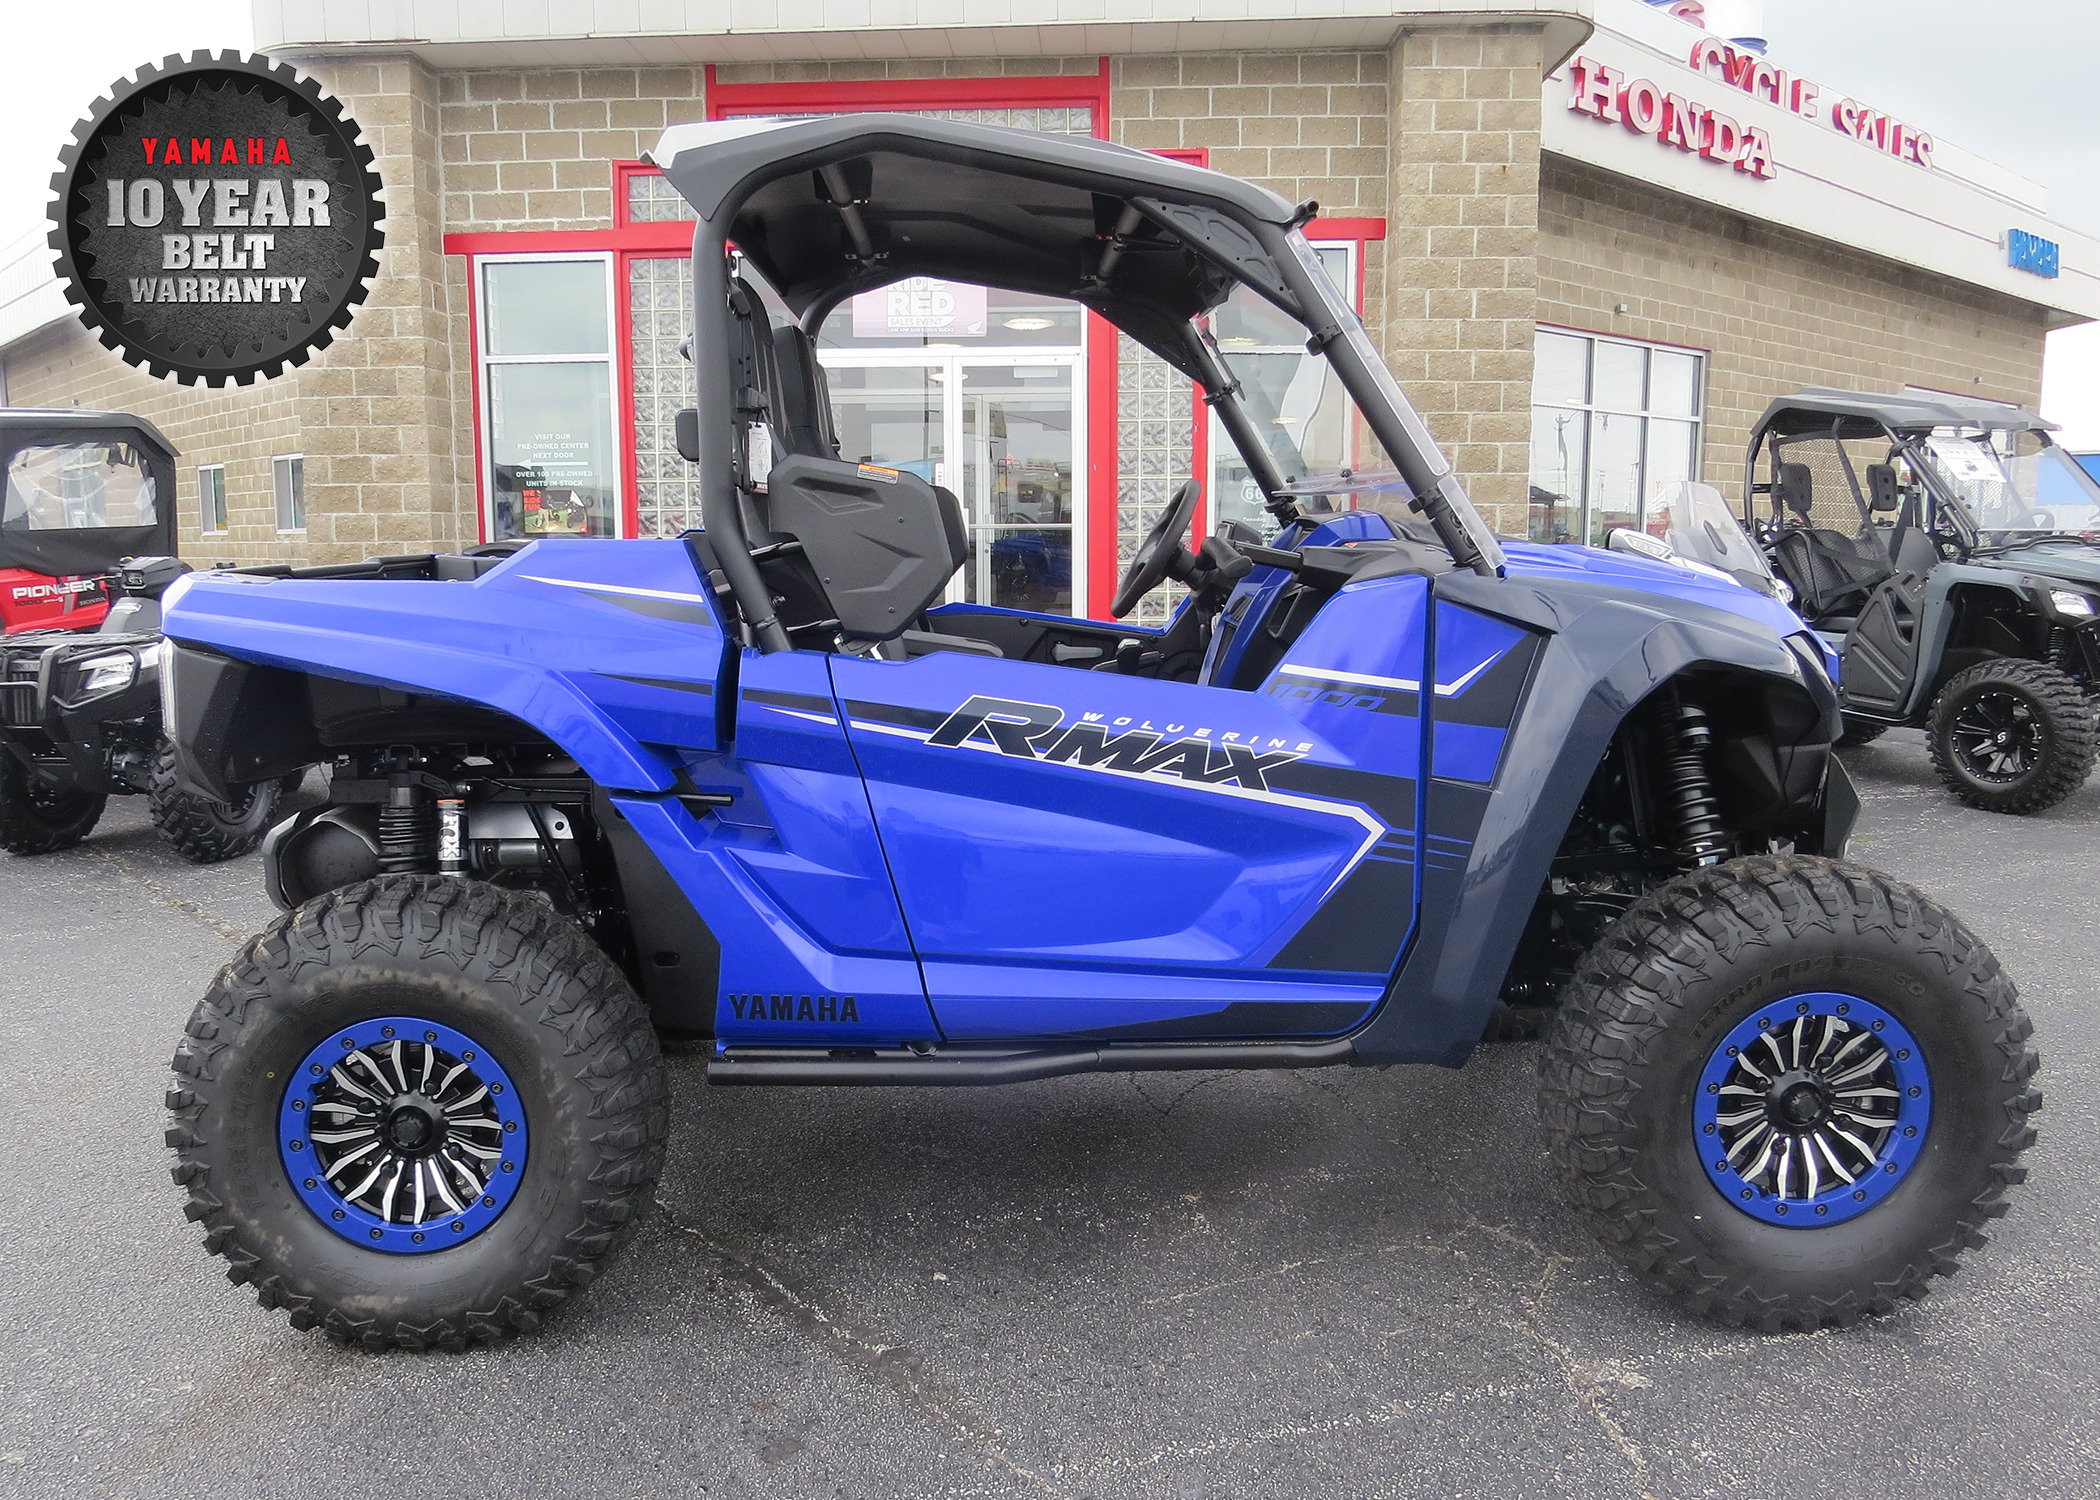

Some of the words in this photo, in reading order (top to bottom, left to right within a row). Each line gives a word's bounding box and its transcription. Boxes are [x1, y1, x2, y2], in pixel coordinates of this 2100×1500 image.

[1568, 56, 1777, 180] HONDA
[888, 291, 956, 316] RED
[890, 317, 914, 326] SALES
[916, 317, 943, 326] EVENT
[1245, 487, 1263, 500] 66
[12, 580, 96, 599] PIONEER
[79, 596, 107, 606] HONDA
[1269, 683, 1387, 712] 1000
[923, 694, 1310, 793] RMAX
[1081, 711, 1315, 752] WOLVERINE
[440, 814, 461, 858] FOX
[728, 993, 859, 1022] YAMAHA
